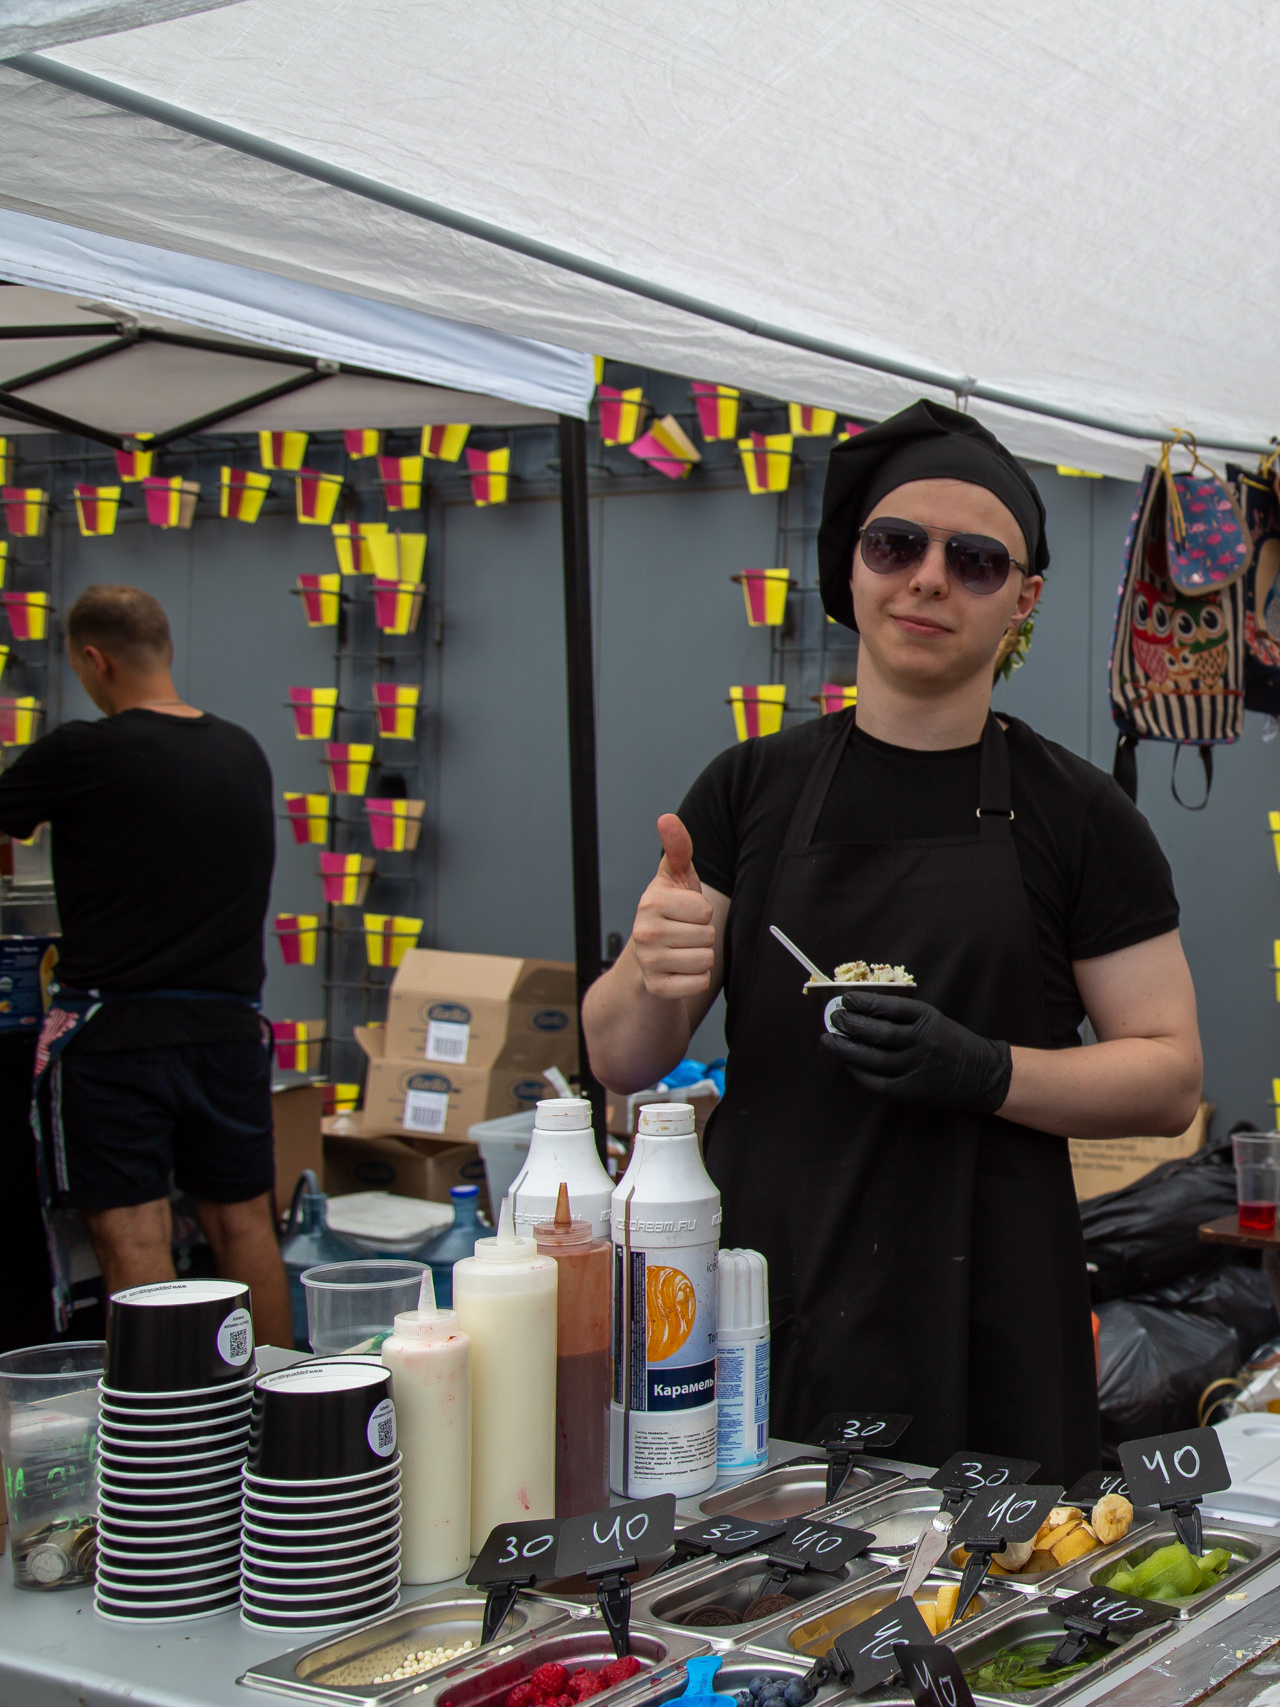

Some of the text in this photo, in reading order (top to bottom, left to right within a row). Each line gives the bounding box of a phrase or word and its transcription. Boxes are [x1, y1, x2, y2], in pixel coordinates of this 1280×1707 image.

[653, 1378, 715, 1399] Карамель
[843, 1420, 886, 1438] 30
[961, 1462, 1009, 1489] 30
[1141, 1445, 1200, 1484] 40
[987, 1492, 1037, 1532] 40
[592, 1512, 649, 1551] 40
[702, 1523, 759, 1542] 30
[791, 1526, 843, 1554] 40
[498, 1534, 554, 1564] 30
[1093, 1596, 1144, 1622] 40
[859, 1618, 910, 1660] 40
[912, 1659, 957, 1707] 40
